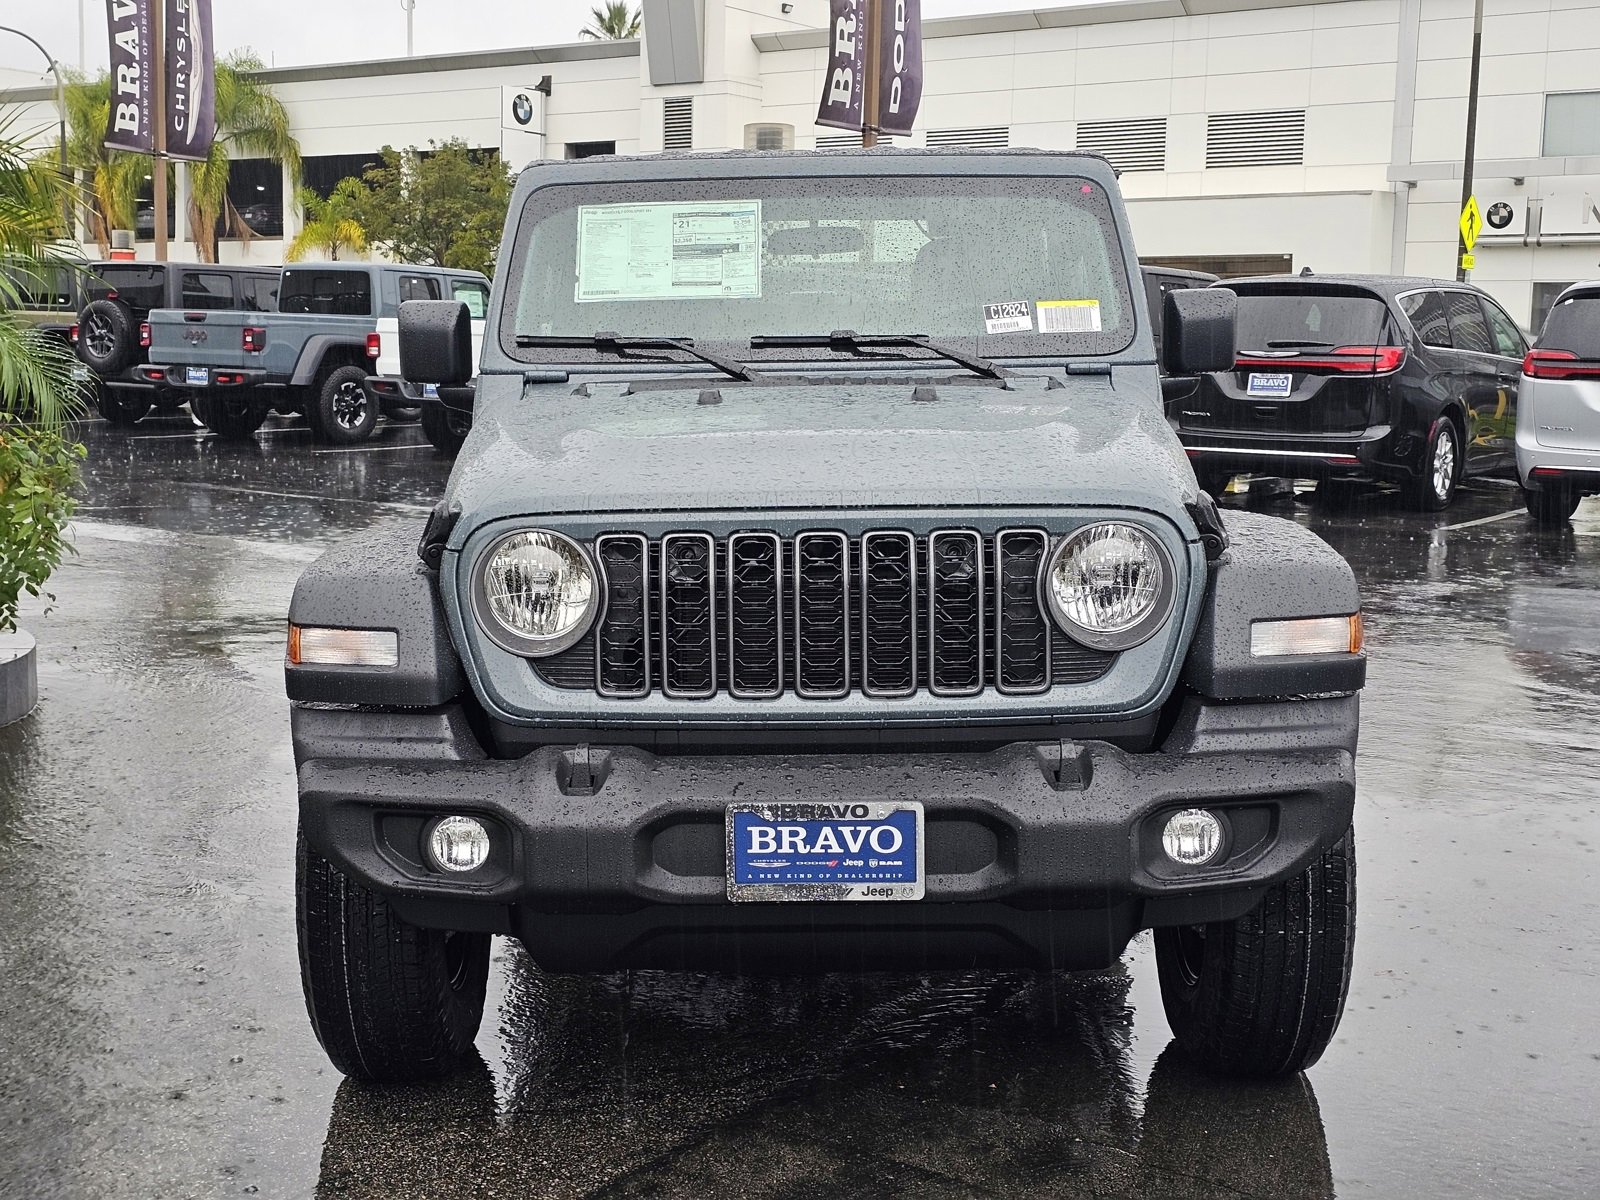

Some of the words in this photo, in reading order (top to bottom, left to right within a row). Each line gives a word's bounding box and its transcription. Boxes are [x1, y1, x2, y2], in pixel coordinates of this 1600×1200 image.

[142, 39, 148, 55] OF
[853, 102, 859, 110] A
[990, 302, 1028, 319] C12824
[1253, 378, 1287, 386] BRAVO
[780, 803, 870, 820] BRAVO
[746, 825, 903, 855] BRAVO
[842, 858, 864, 867] Jeep
[861, 885, 894, 898] Jeep
